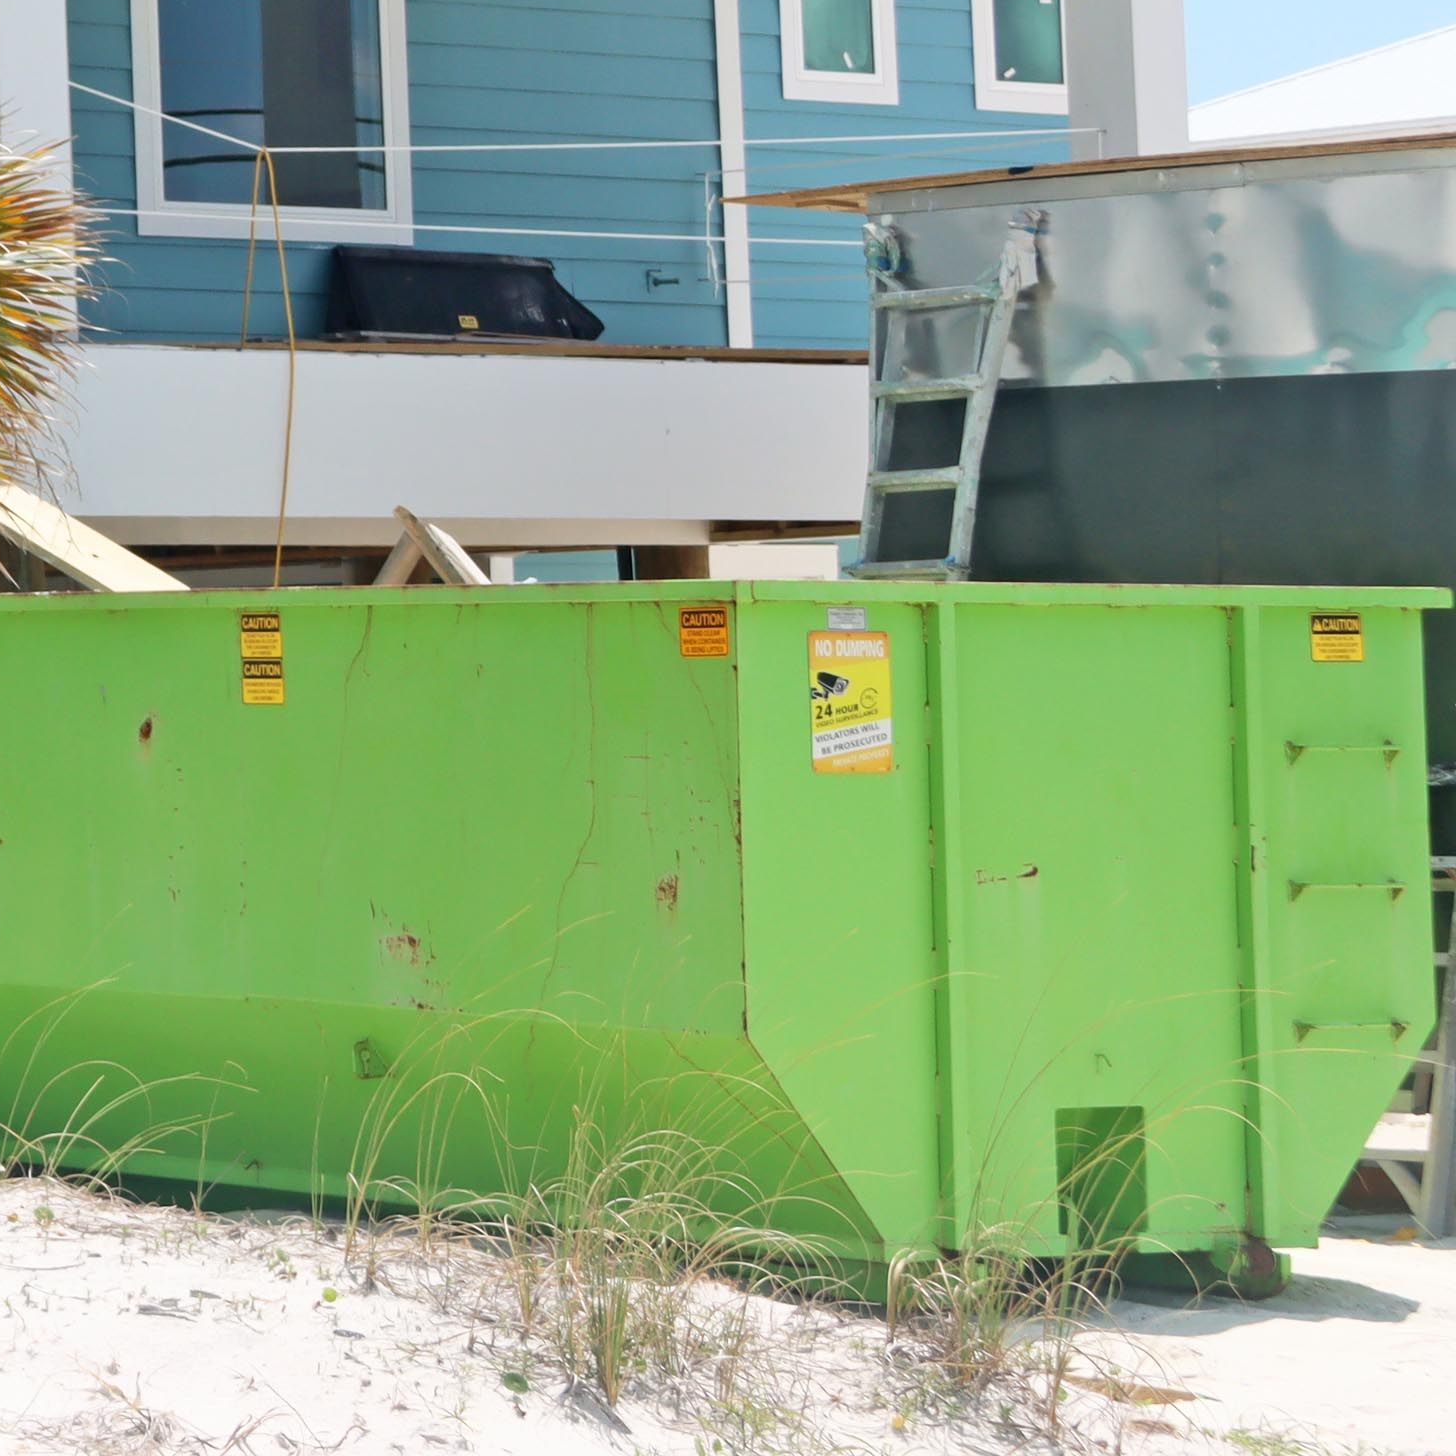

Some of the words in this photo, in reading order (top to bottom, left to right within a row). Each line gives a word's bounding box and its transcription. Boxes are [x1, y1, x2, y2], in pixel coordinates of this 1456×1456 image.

[242, 617, 279, 629] CAUTION
[682, 613, 724, 626] CAUTION
[1322, 619, 1360, 631] CAUTION
[816, 640, 833, 657] NO
[836, 640, 884, 657] DUMPING
[244, 663, 281, 676] CAUTION
[816, 703, 833, 719] 24
[835, 704, 859, 715] HOUR
[815, 726, 860, 743] VIOLATORS
[861, 722, 880, 732] WILL
[821, 747, 832, 755] BE
[834, 733, 888, 752] PROSECUTED
